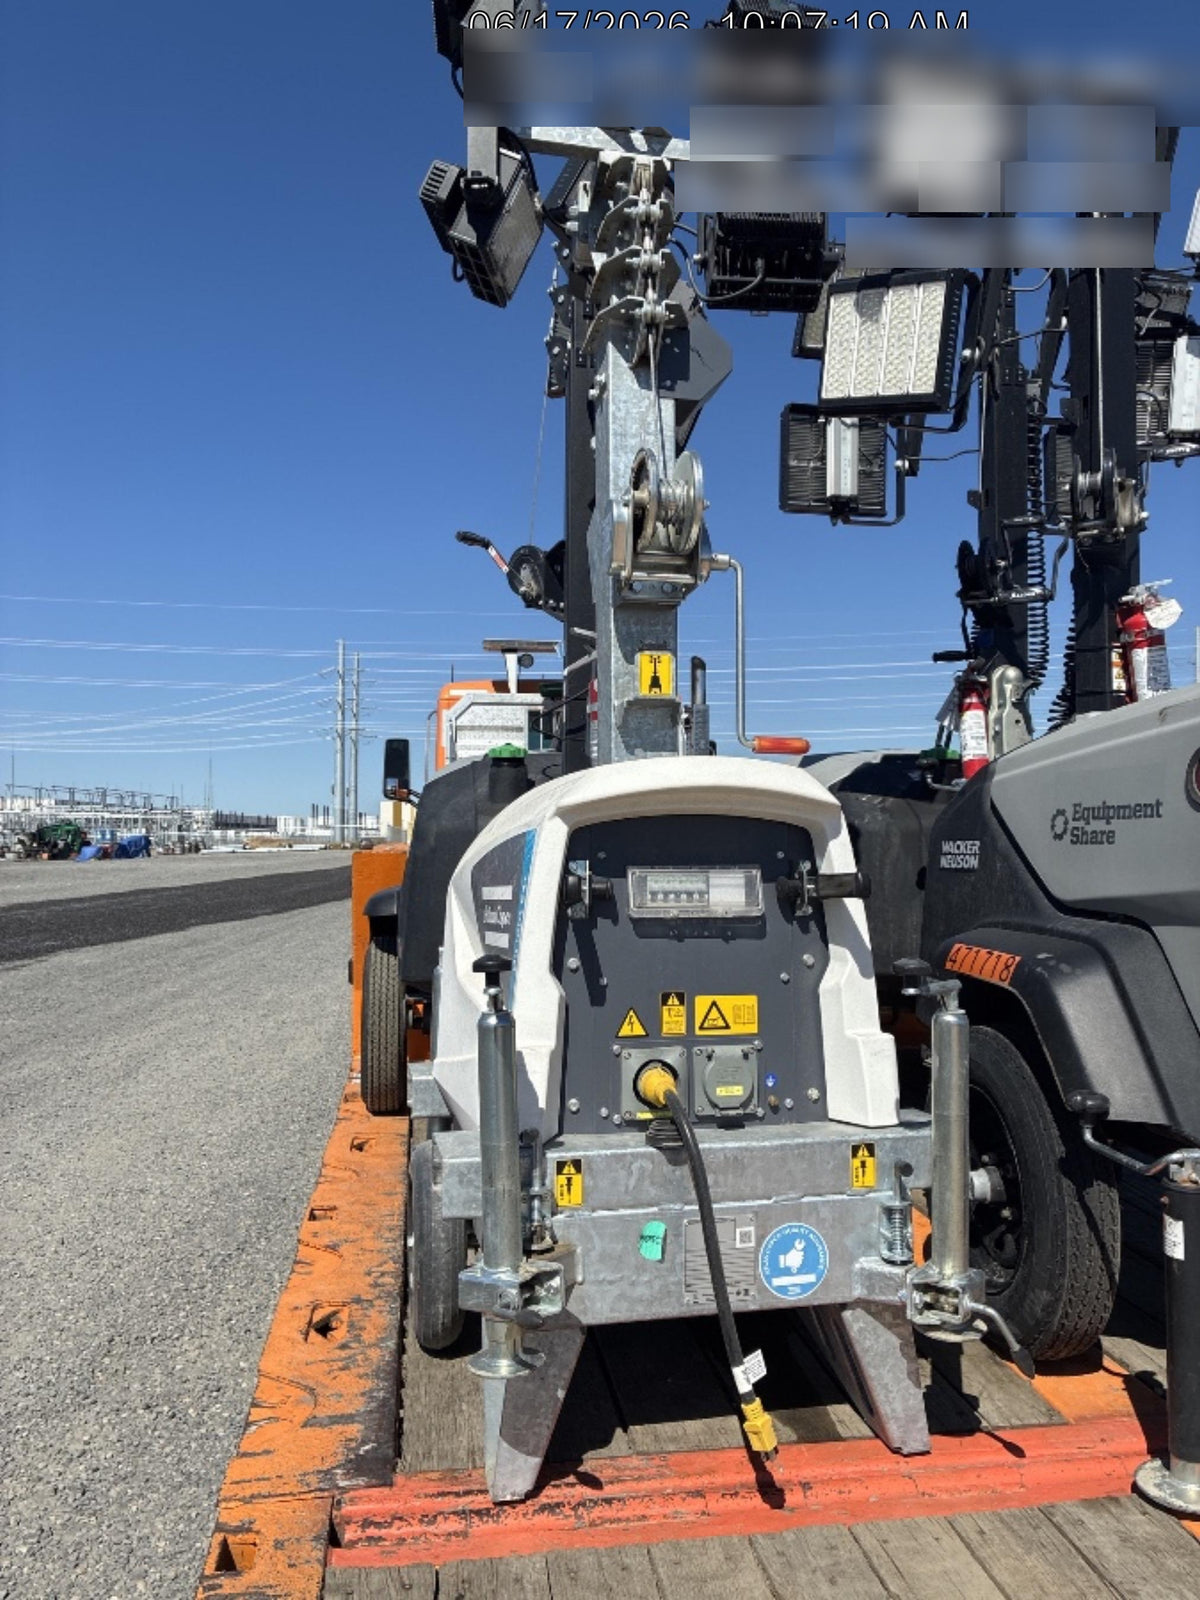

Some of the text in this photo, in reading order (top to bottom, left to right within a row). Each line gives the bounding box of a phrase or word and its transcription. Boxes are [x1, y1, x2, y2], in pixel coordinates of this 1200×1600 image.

[1072, 798, 1163, 825] Equipment
[1070, 826, 1116, 845] Share
[941, 840, 980, 854] WACKER
[940, 855, 979, 869] NEUSON
